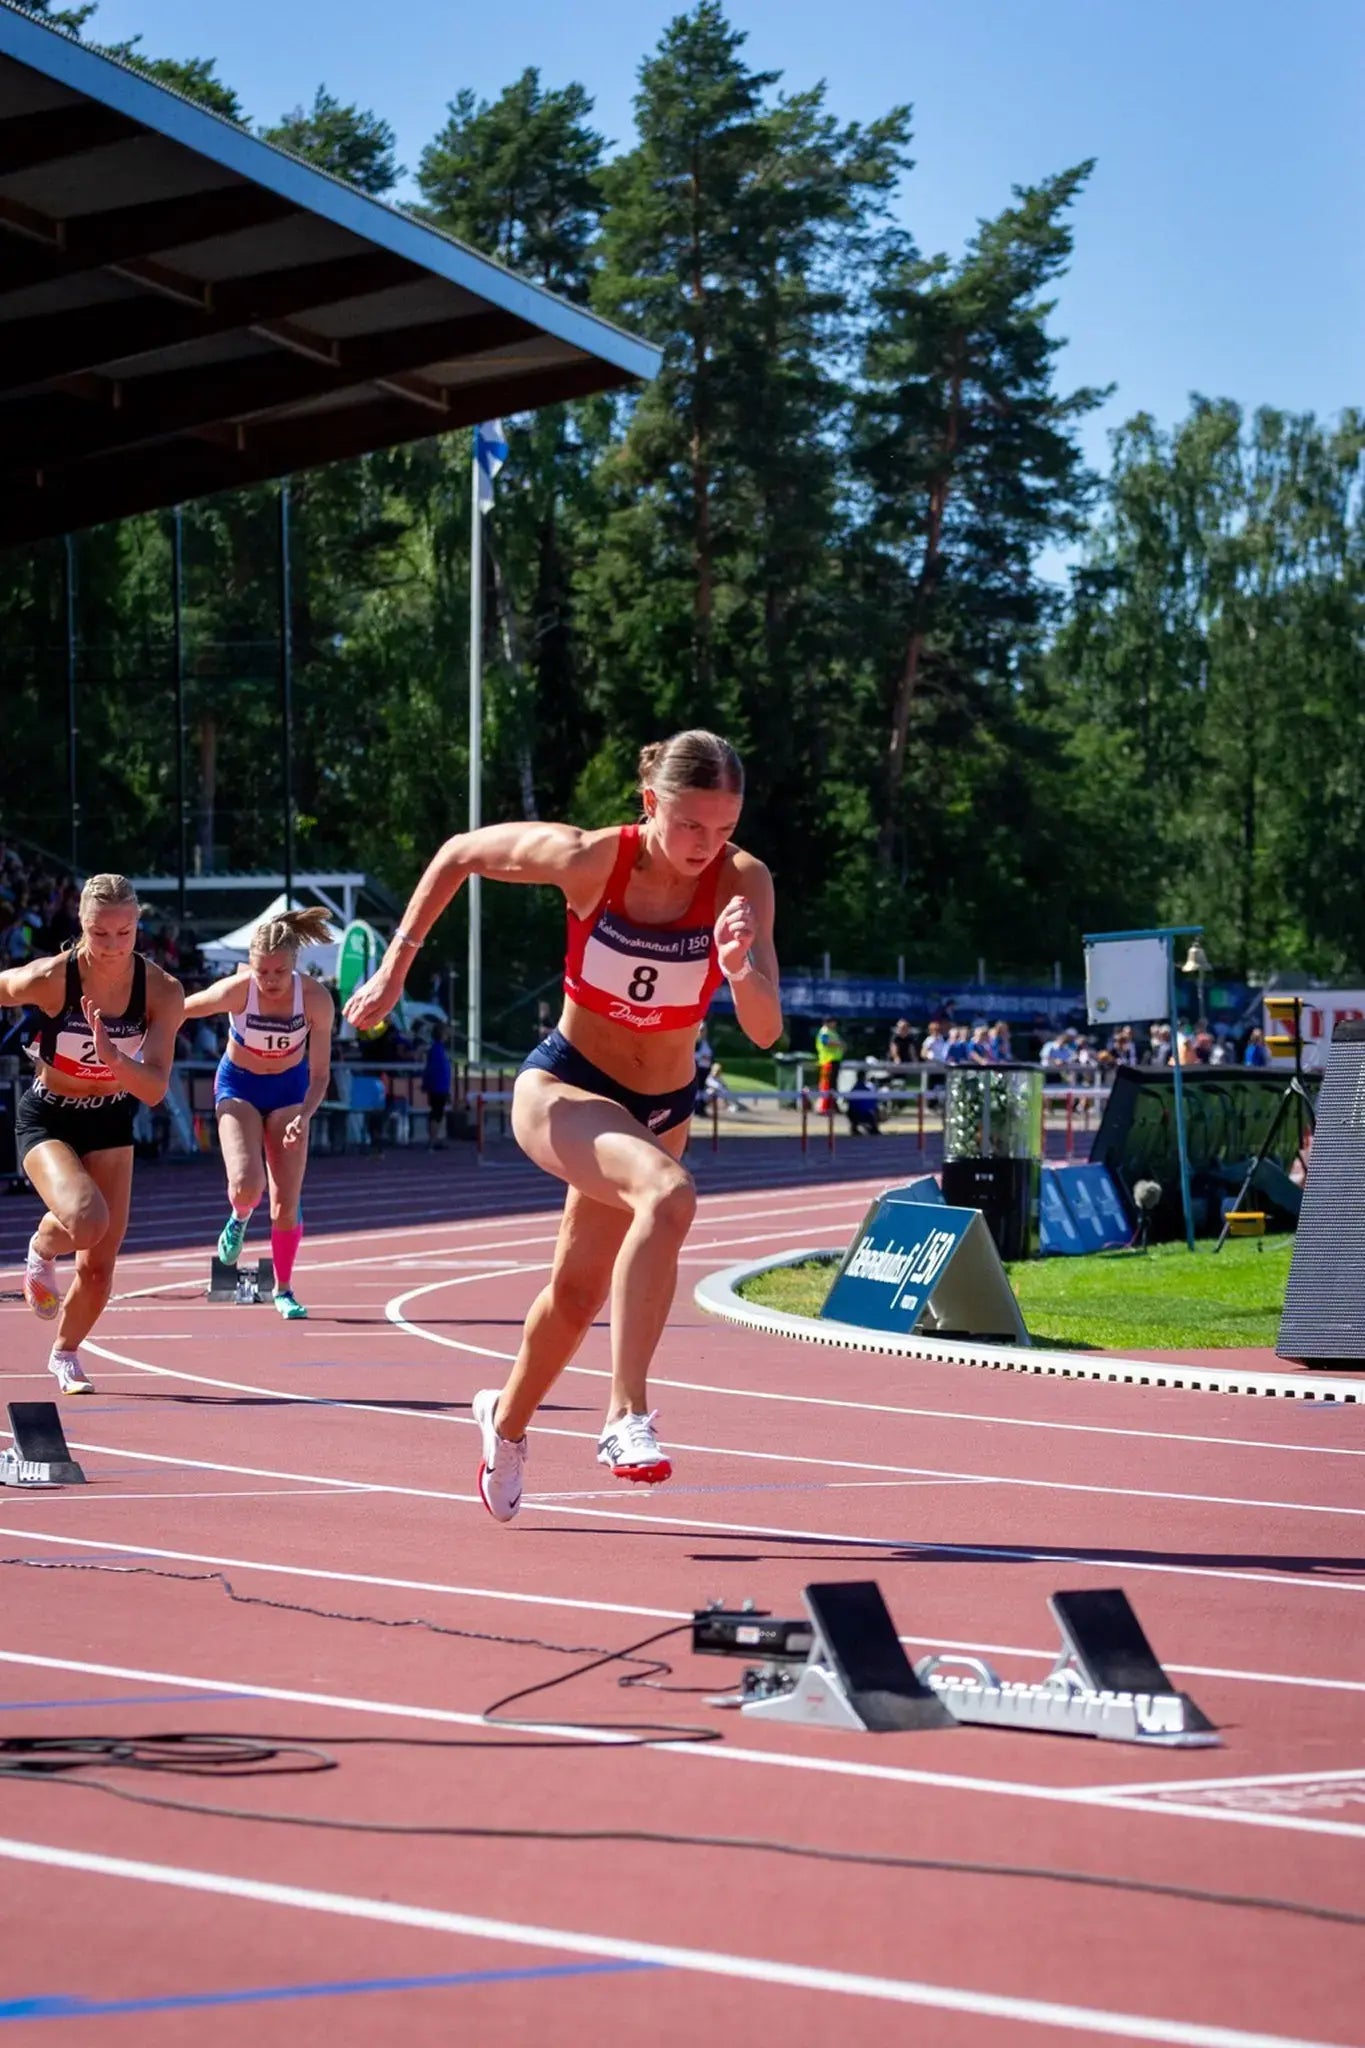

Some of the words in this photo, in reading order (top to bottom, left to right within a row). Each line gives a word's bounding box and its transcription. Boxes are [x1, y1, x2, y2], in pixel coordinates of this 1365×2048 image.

[687, 935, 710, 951] 150
[628, 966, 658, 1002] 8
[264, 1035, 290, 1050] 16
[61, 1096, 105, 1109] PRO
